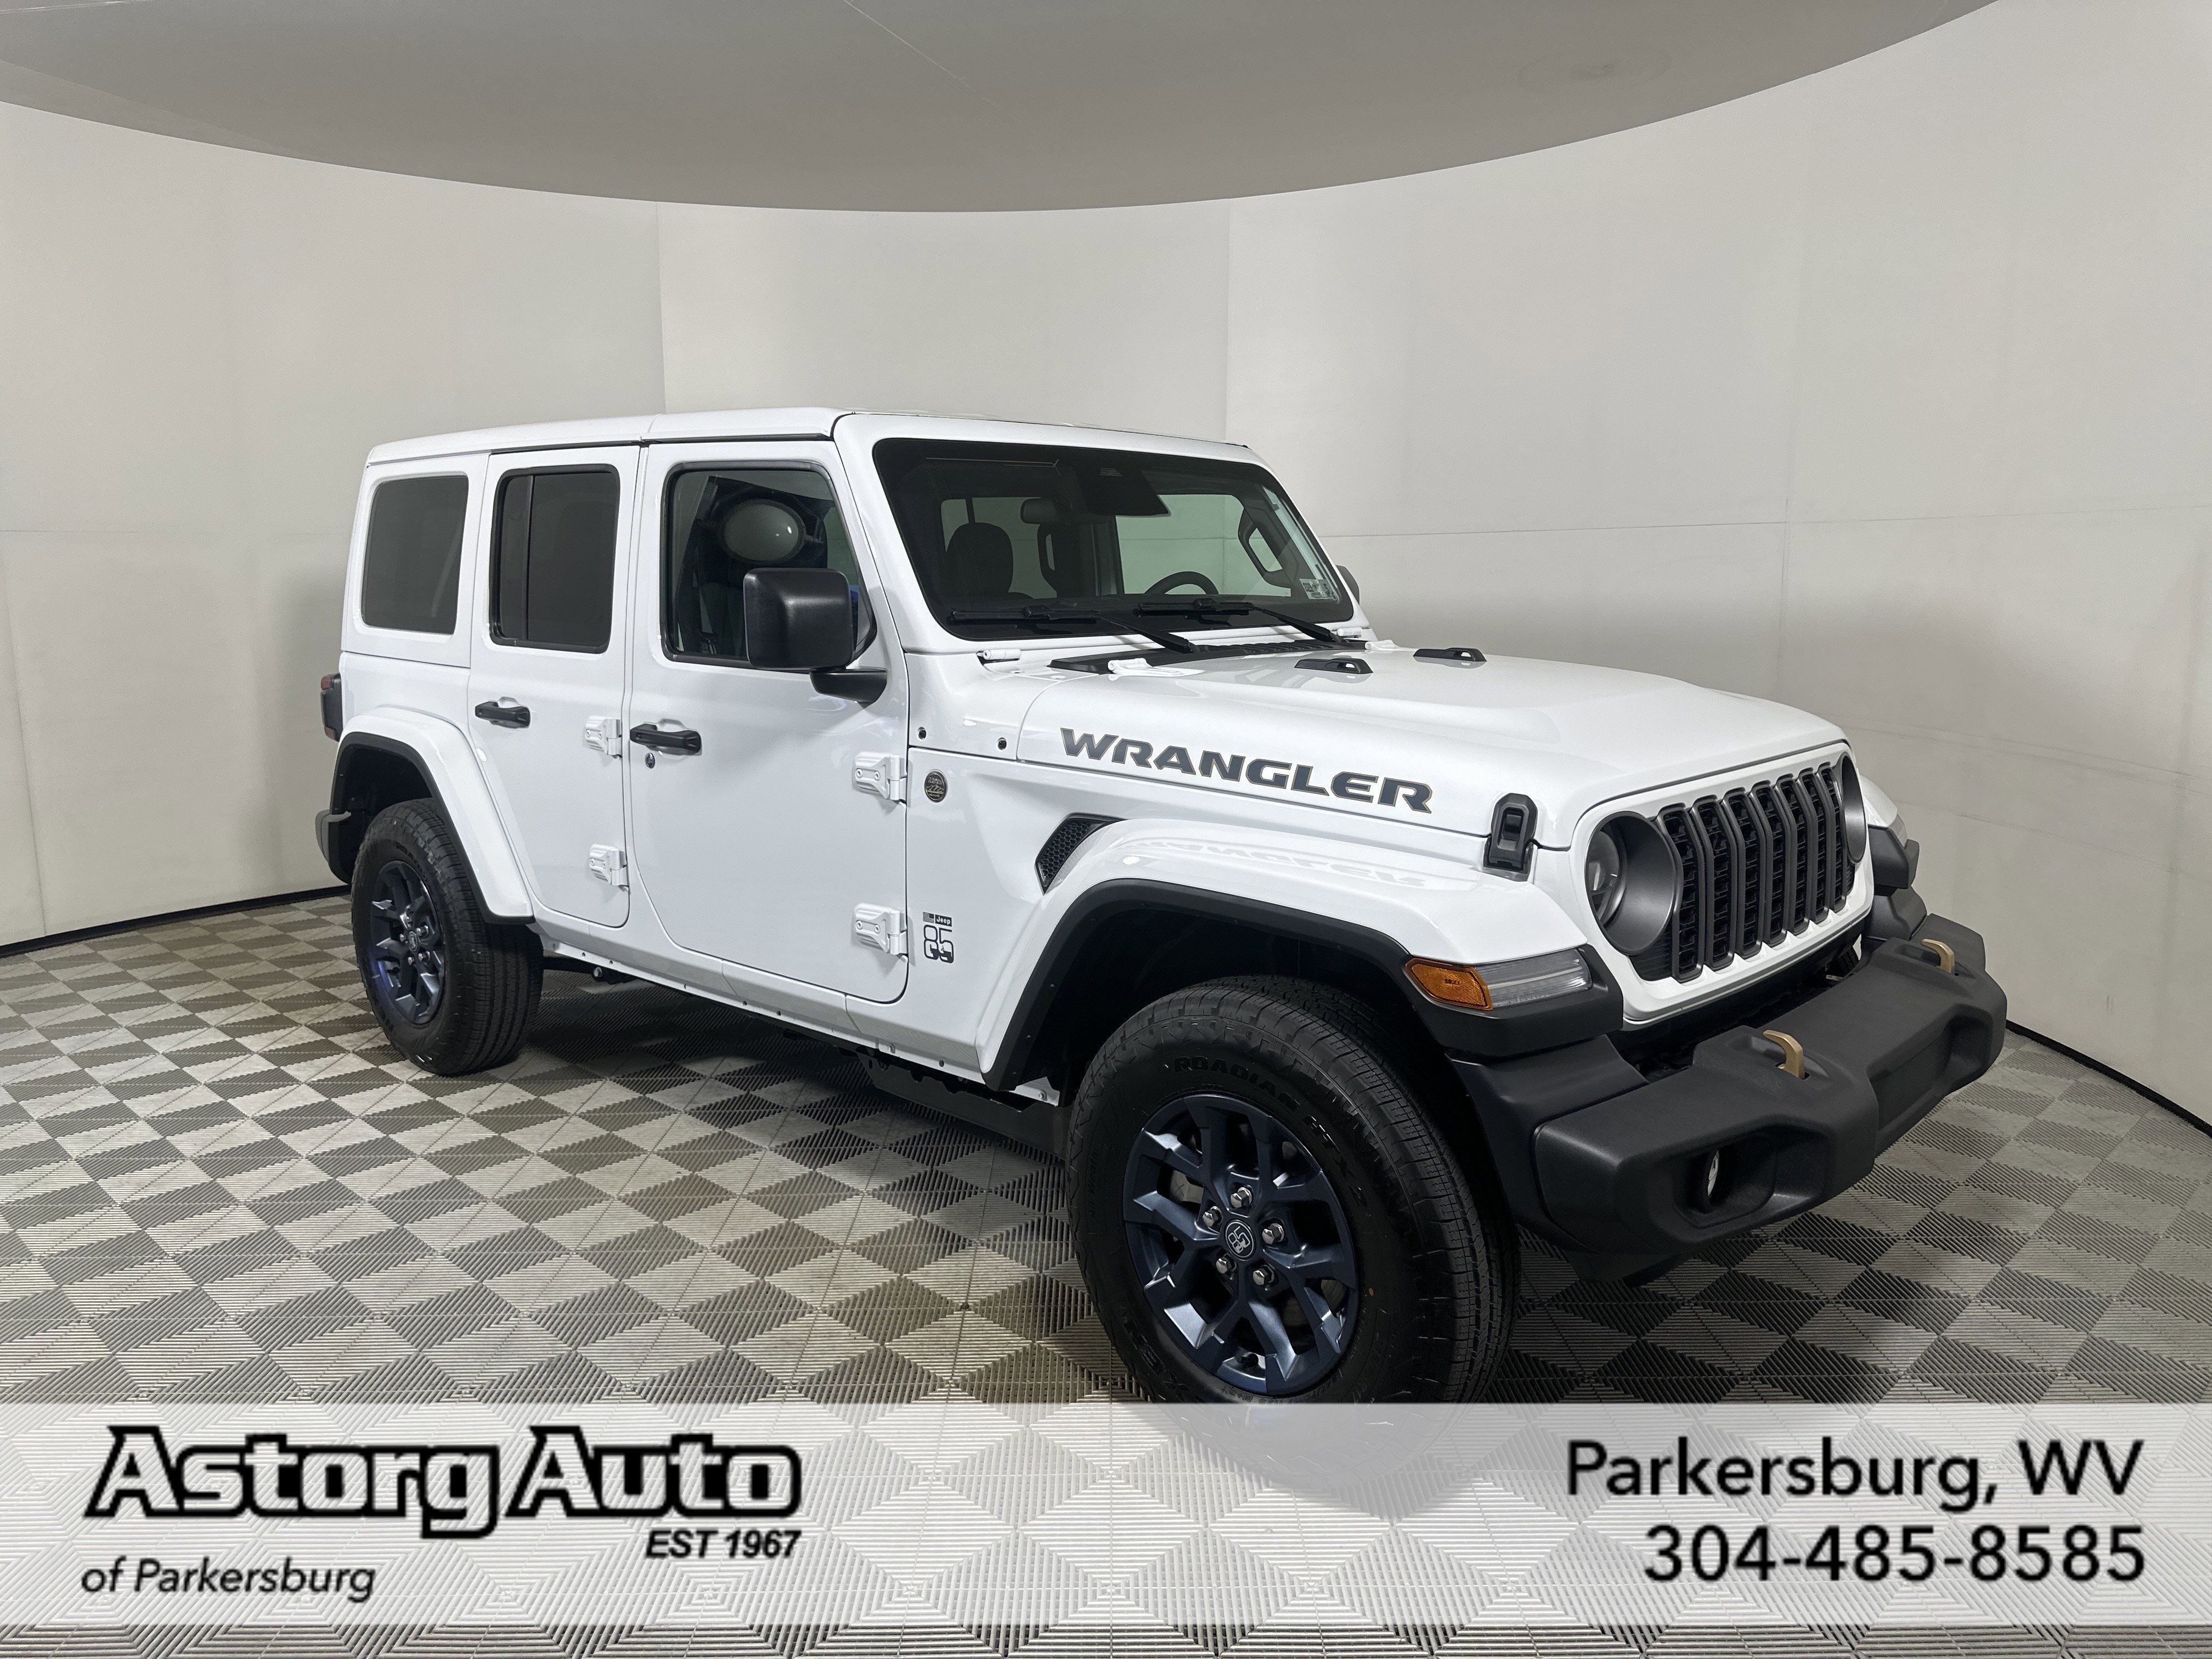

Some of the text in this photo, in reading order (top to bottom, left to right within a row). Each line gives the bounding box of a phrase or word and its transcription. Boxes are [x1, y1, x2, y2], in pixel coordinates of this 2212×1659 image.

[1060, 727, 1433, 814] WRANGLER
[936, 915, 951, 926] Jeep
[923, 924, 954, 963] 85
[1174, 1055, 1302, 1117] ROADIAN
[1228, 1226, 1251, 1254] 85
